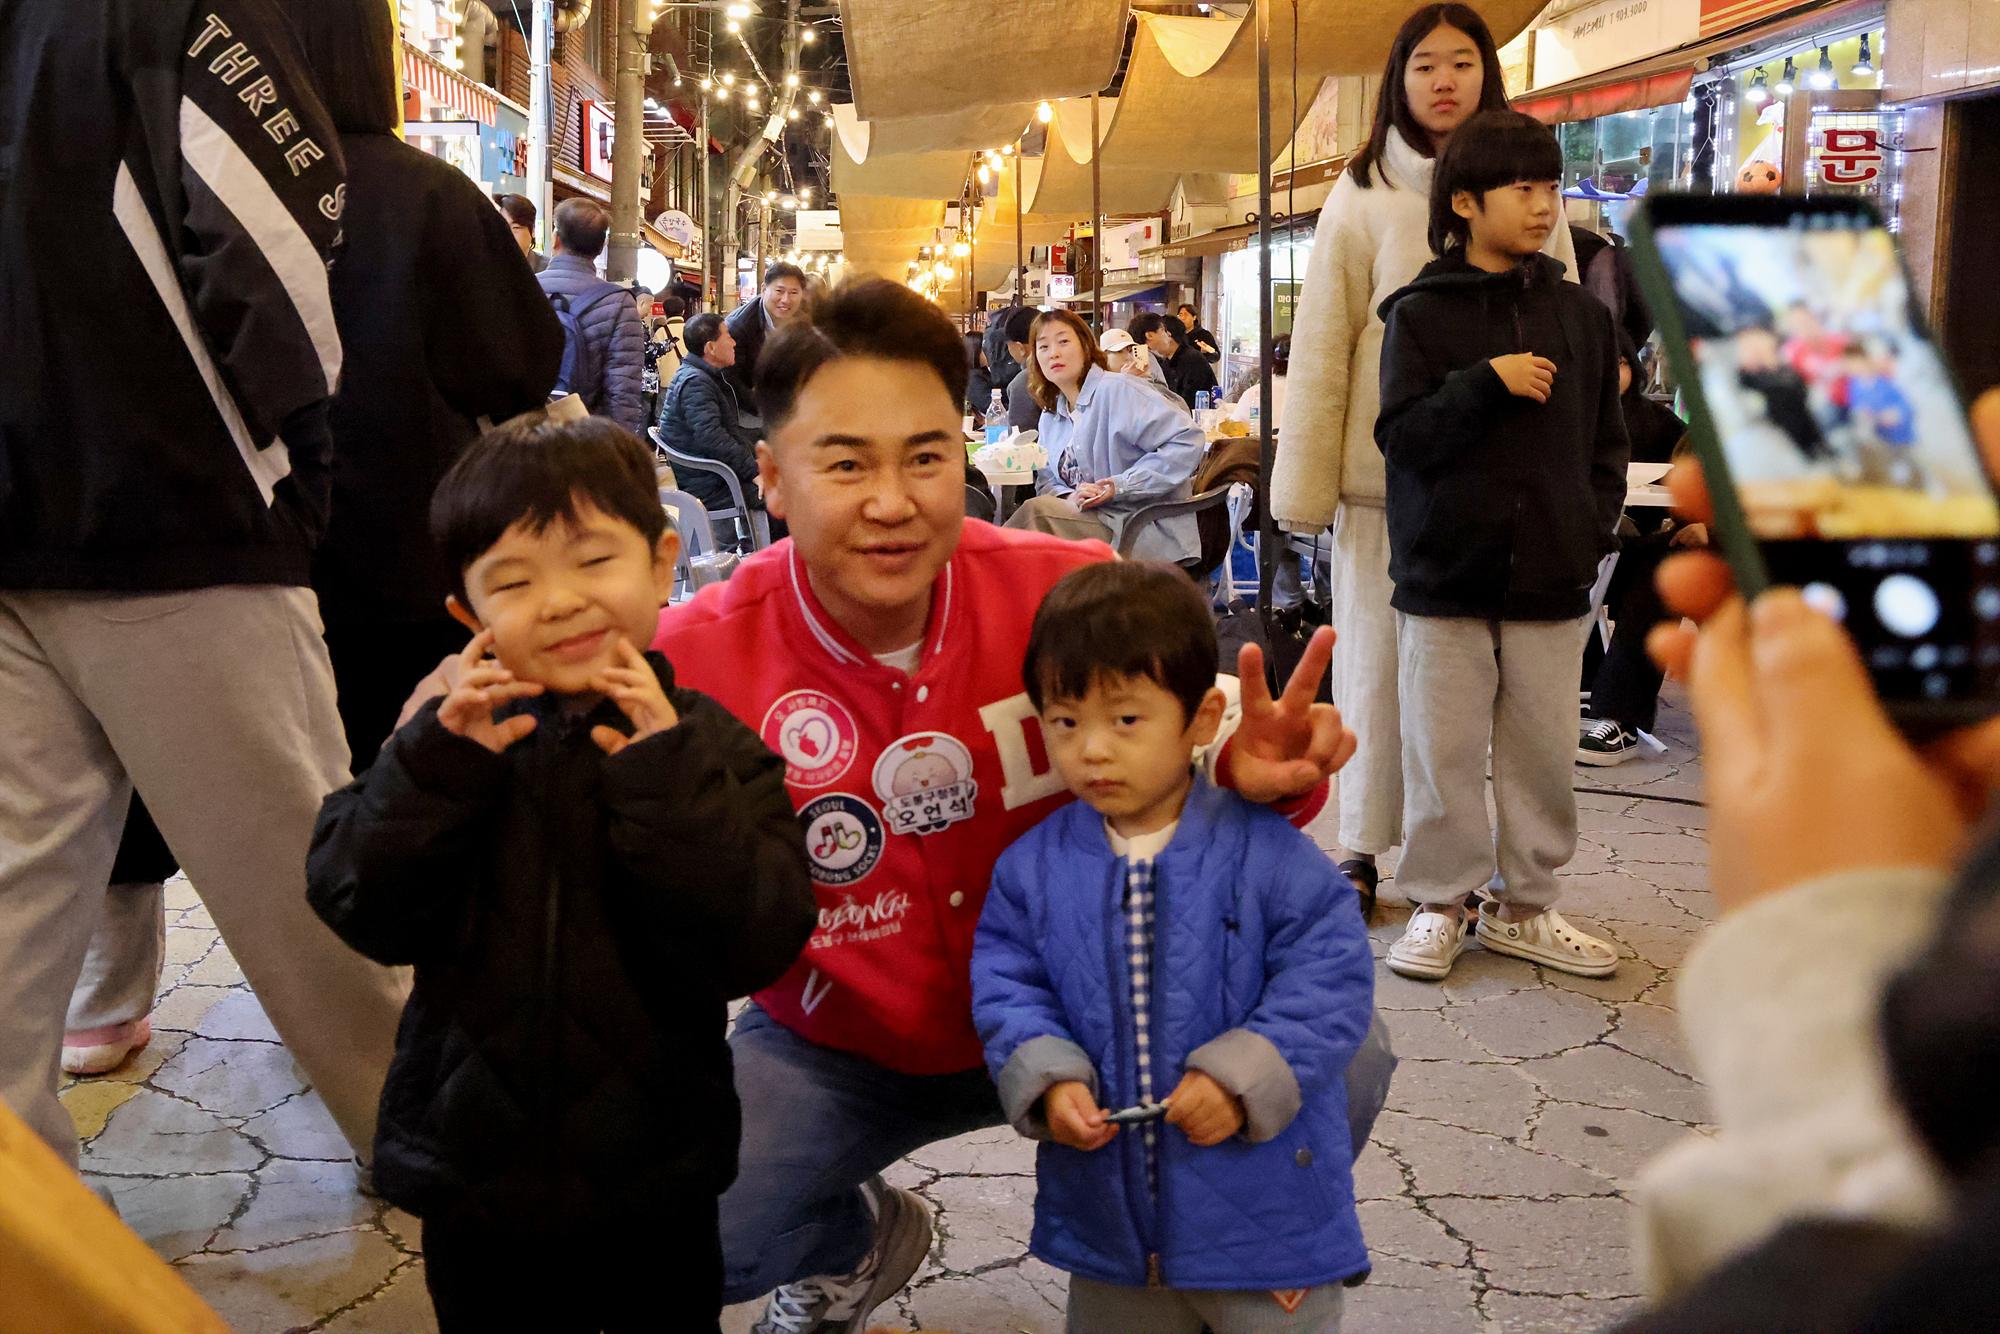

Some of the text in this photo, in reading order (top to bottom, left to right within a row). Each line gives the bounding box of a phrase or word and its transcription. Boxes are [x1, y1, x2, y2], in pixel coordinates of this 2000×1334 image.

[1610, 12, 1615, 24] T
[1616, 1, 1647, 22] 903.3000
[187, 13, 325, 177] THREE
[1819, 128, 1882, 183] 문
[661, 216, 687, 227] 손칼국수
[808, 800, 846, 819] SEOUL
[899, 796, 968, 828] 오언석
